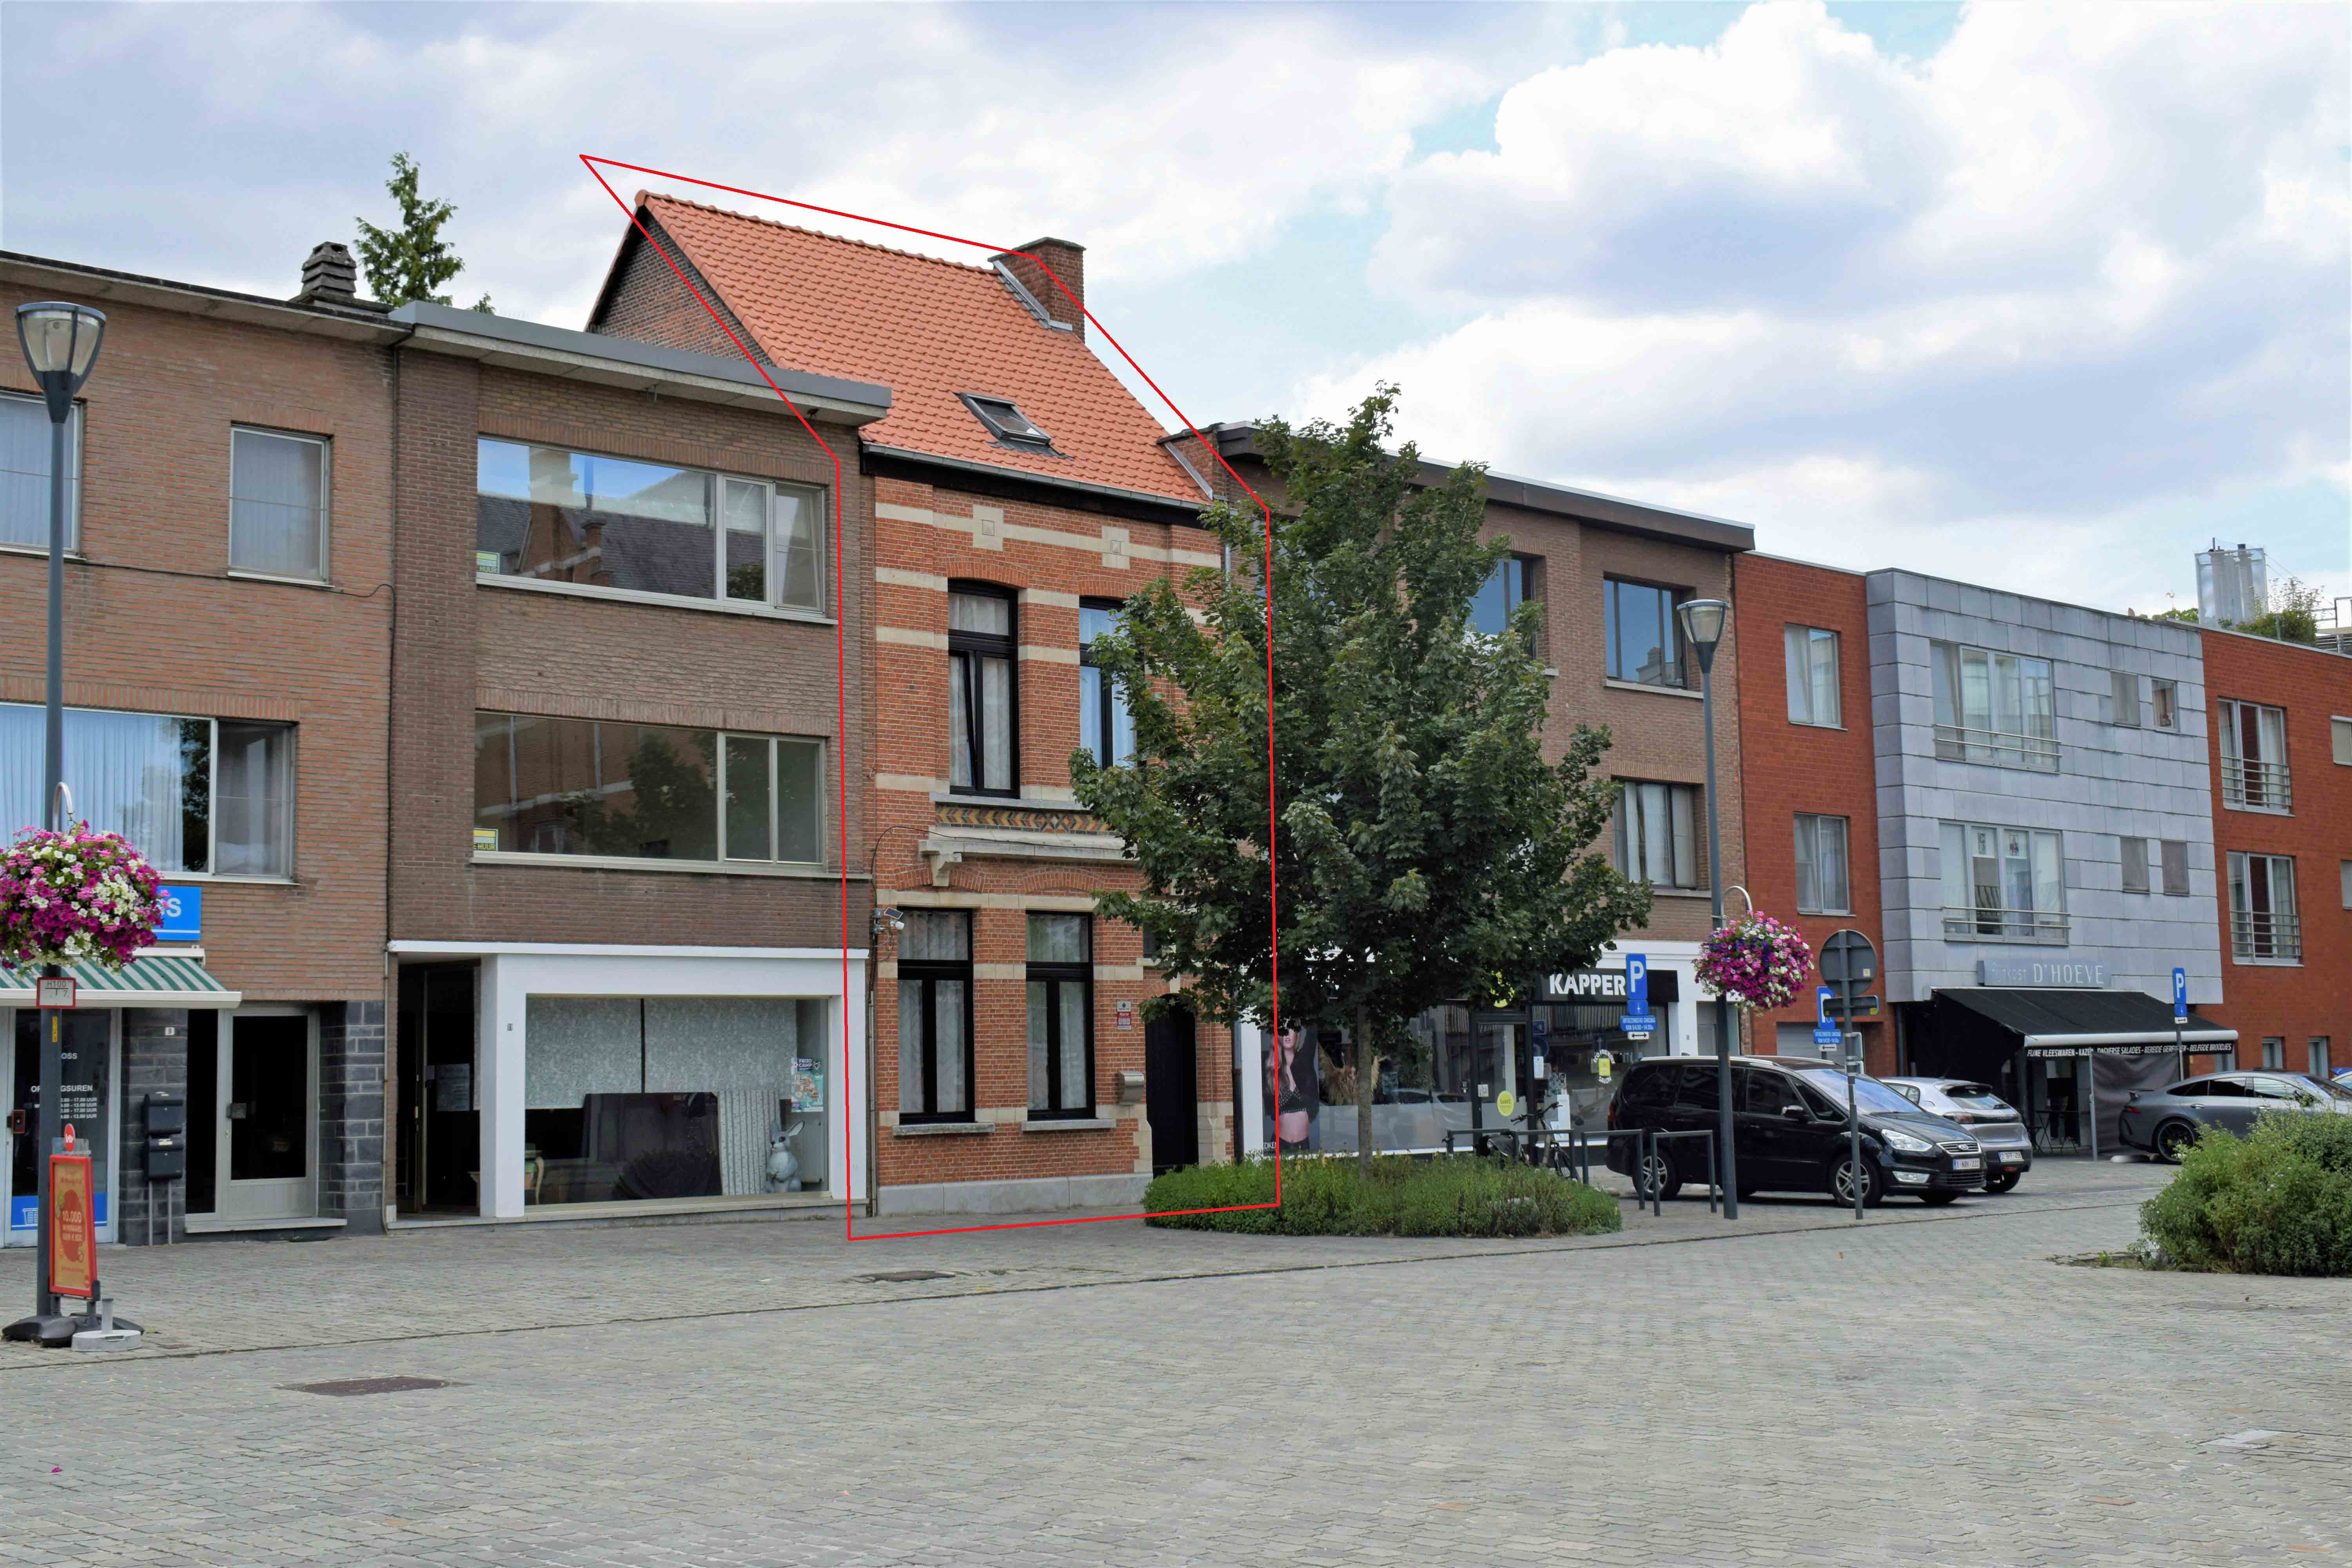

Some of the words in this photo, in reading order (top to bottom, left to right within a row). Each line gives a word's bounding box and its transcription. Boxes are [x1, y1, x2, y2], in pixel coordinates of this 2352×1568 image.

[1550, 973, 1626, 995] KAPPER
[1630, 961, 1644, 993] P
[2176, 973, 2184, 998] P
[2042, 1048, 2075, 1057] VLEESWAREN
[2120, 1046, 2141, 1054] SALADES
[2209, 1043, 2232, 1051] BROODJES
[62, 1210, 82, 1223] 10.000
